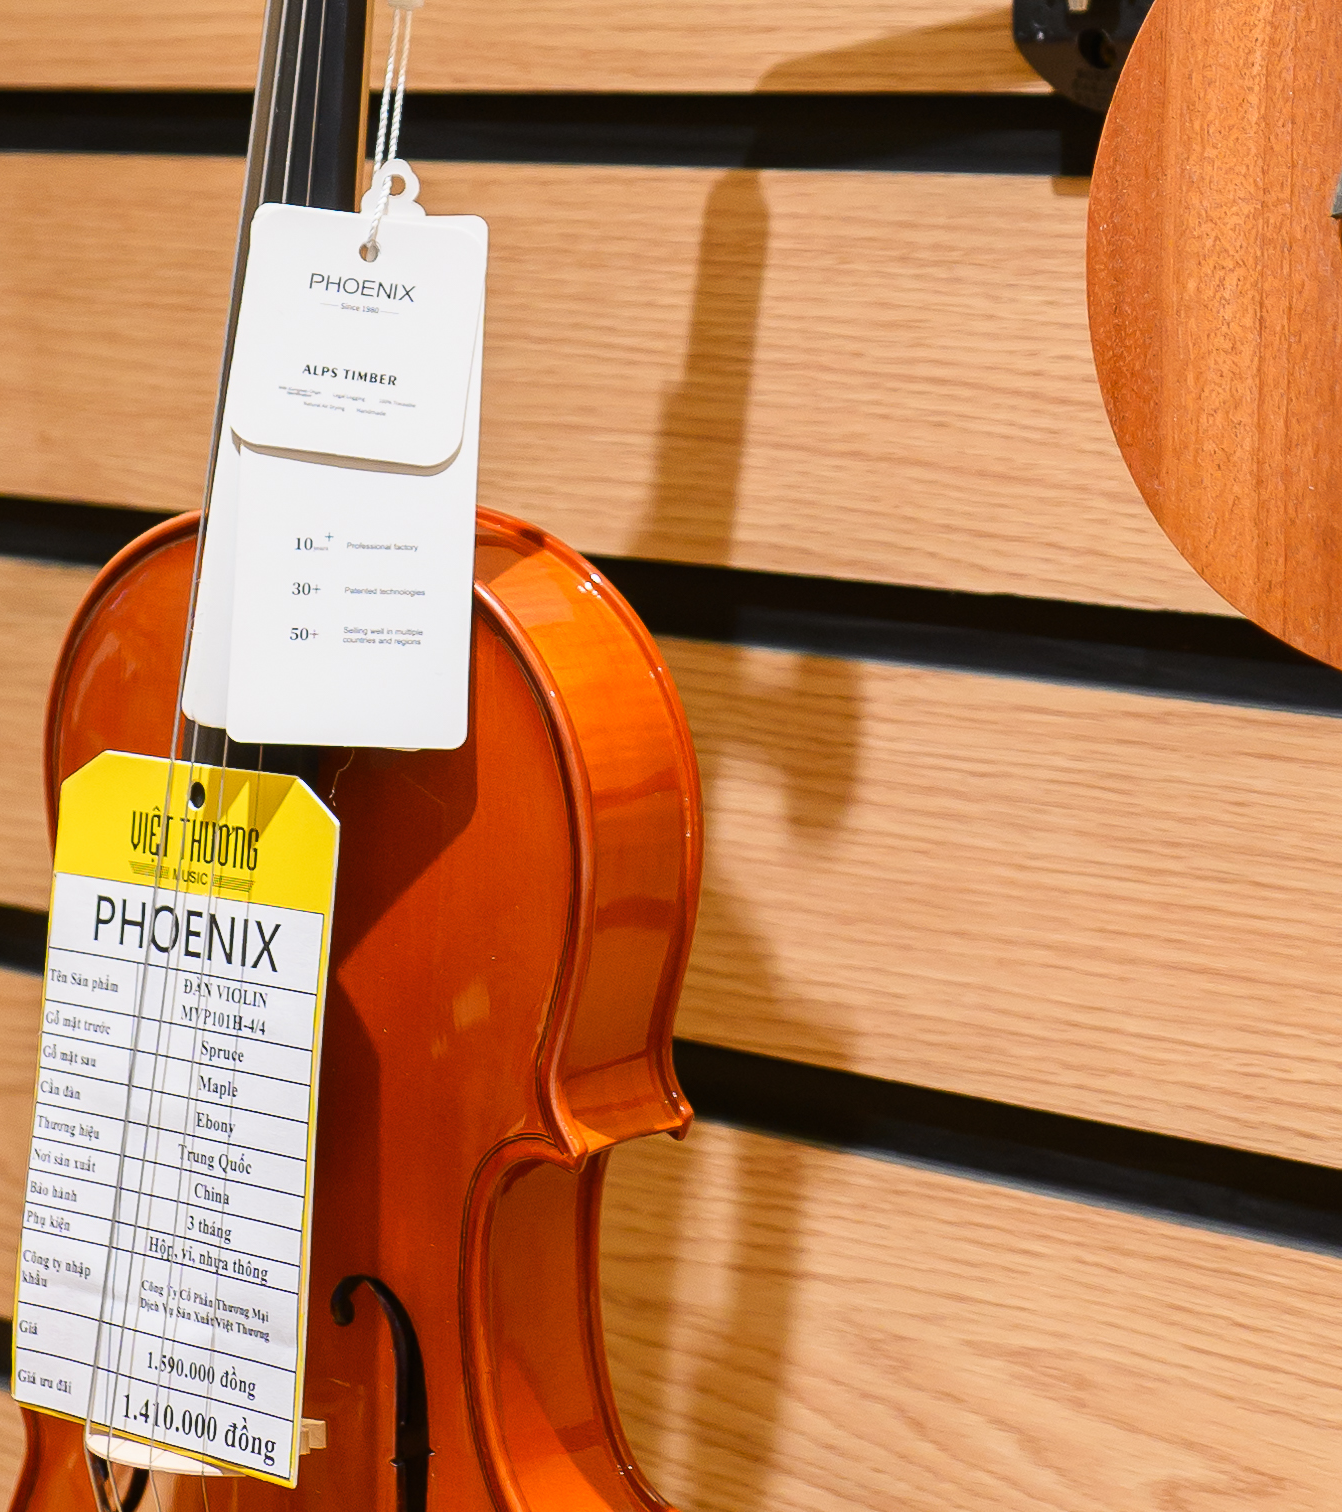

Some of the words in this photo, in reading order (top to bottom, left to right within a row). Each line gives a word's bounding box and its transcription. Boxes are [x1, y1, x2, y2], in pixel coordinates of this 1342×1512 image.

[309, 272, 416, 302] PHOENIX
[341, 302, 360, 312] Since
[302, 364, 339, 379] ALPS
[343, 368, 397, 386] TIMBER
[295, 537, 313, 551] 10
[346, 541, 391, 550] Professional
[393, 543, 418, 552] factory
[344, 587, 377, 595] Patented
[379, 588, 425, 597] technologies
[343, 626, 368, 635] Selling
[370, 627, 384, 635] well
[395, 627, 423, 636] multiple
[378, 637, 392, 645] and
[394, 638, 421, 646] regions
[131, 806, 173, 862] VIỆT
[180, 817, 259, 871] THƯƠNG
[172, 868, 208, 885] MUSIC
[93, 895, 282, 973] PHOENIX
[183, 976, 212, 998] ĐÀN
[217, 984, 268, 1009] VIOLIN
[181, 1004, 265, 1036] MVP101H-4/4
[201, 1040, 244, 1062] Spruce
[199, 1075, 238, 1099] Maple
[196, 1112, 235, 1137] Ebony
[178, 1143, 214, 1171] Trung
[219, 1153, 252, 1175] Quốc
[194, 1183, 230, 1205] China
[187, 1216, 194, 1231] 3
[198, 1218, 232, 1244] tháng
[199, 1250, 228, 1274] nhựa
[233, 1259, 268, 1285] thông
[147, 1351, 215, 1384] 1.590.000
[220, 1366, 256, 1401] đồng
[123, 1394, 217, 1442] 1.410.000
[224, 1416, 276, 1467] đồng
